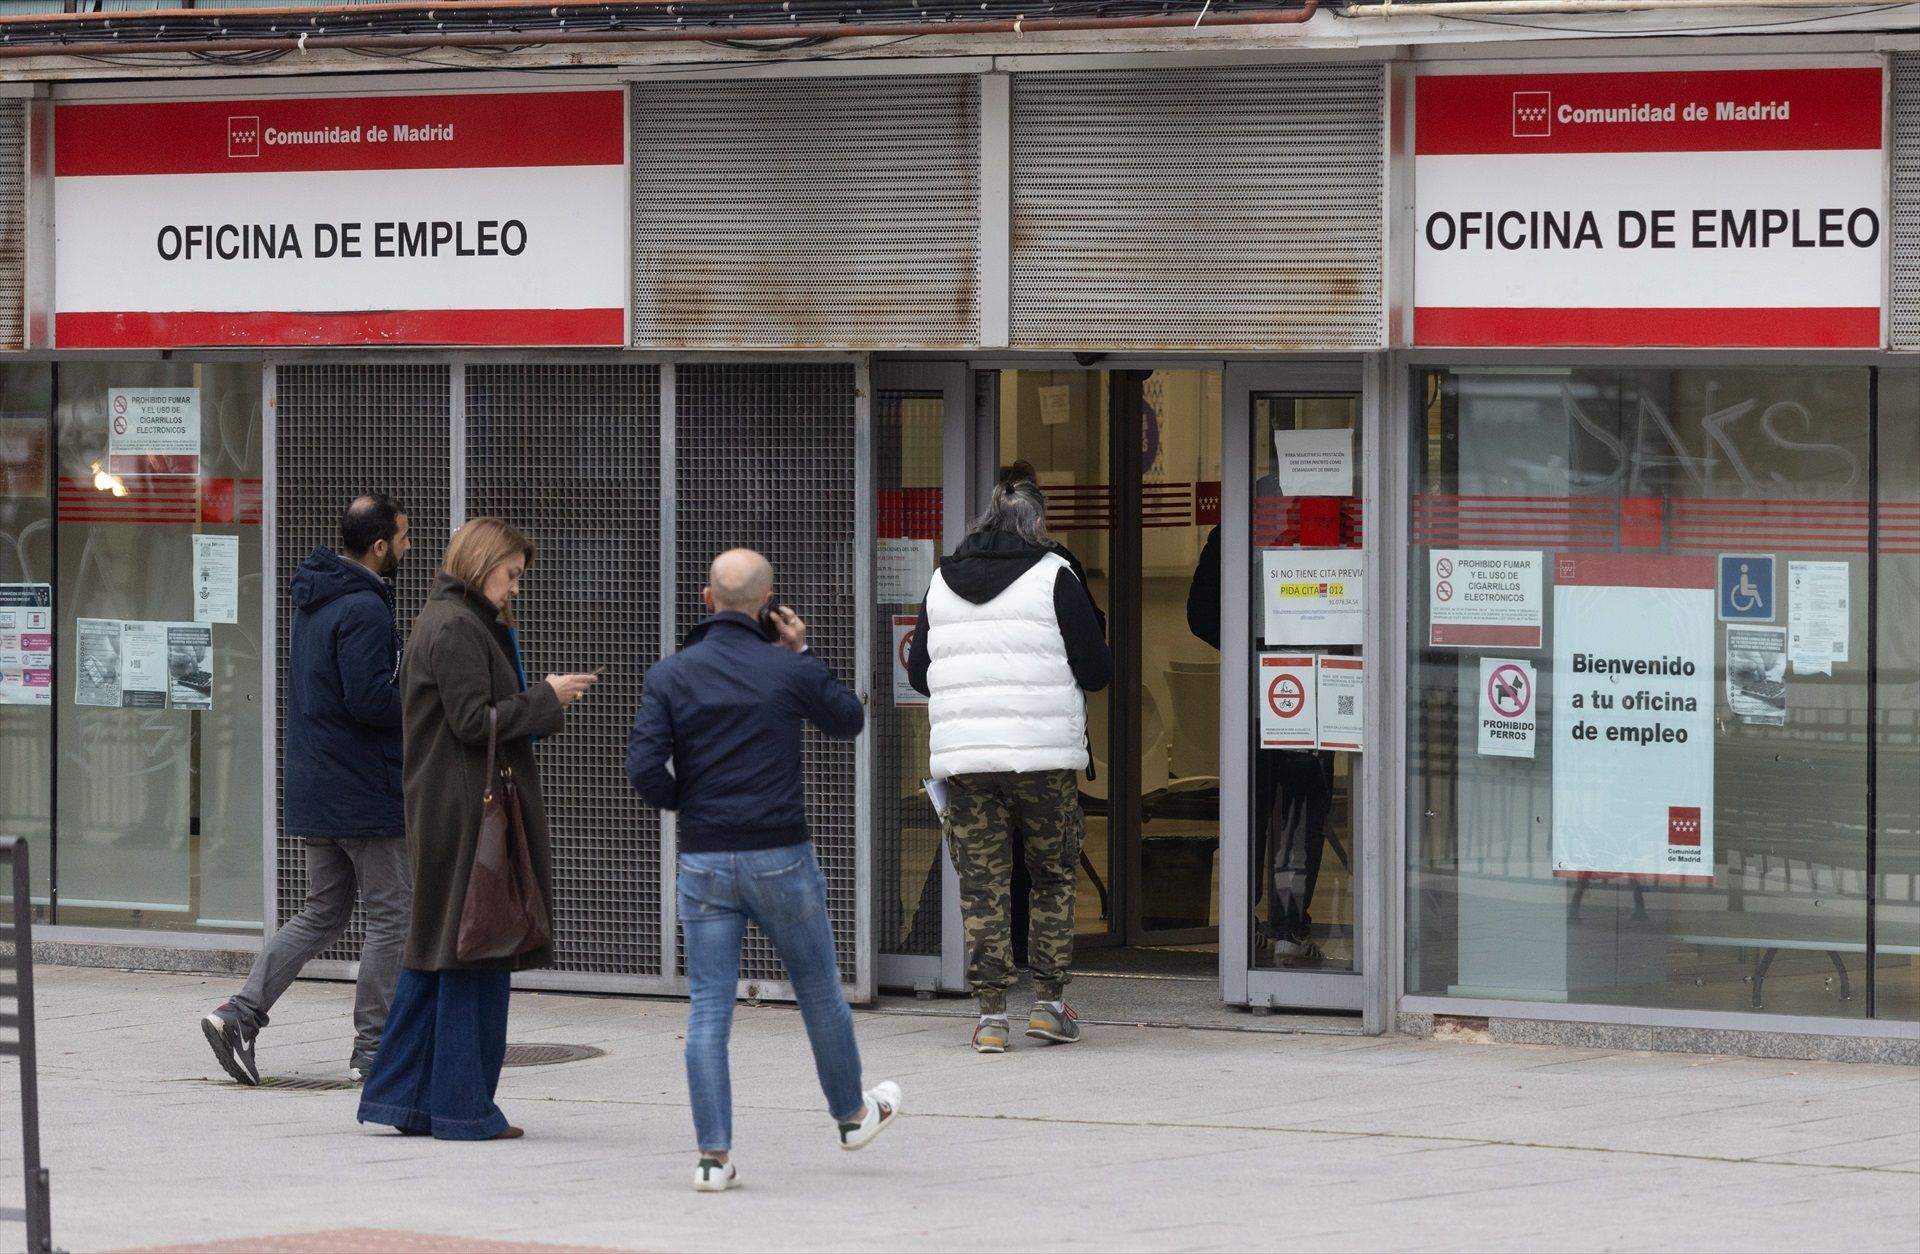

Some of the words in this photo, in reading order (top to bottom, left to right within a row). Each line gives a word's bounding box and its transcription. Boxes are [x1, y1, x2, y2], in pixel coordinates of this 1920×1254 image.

[1557, 103, 1676, 124] Comunidad
[1683, 102, 1709, 122] de
[1715, 101, 1790, 121] Madrid
[264, 127, 361, 145] Comunidad
[366, 126, 388, 142] de
[393, 124, 454, 142] Madrid
[1425, 210, 1603, 251] OFICINA
[1618, 210, 1676, 249] DE
[1692, 207, 1880, 249] EMPLEO
[156, 223, 301, 261] OFICINA
[314, 223, 362, 259] DE
[374, 219, 528, 258] EMPLEO
[132, 396, 167, 404] PROHIBIDO
[168, 396, 191, 404] FUMAR
[157, 406, 170, 414] USO
[172, 406, 181, 414] DE
[140, 416, 183, 424] CIGARRILLOS
[1458, 560, 1501, 568] PROHIBIDO
[1504, 560, 1531, 568] FUMAR
[1271, 570, 1277, 578] SI
[1280, 570, 1293, 578] NO
[1296, 569, 1317, 578] TIENE
[1320, 569, 1336, 578] CITA
[1478, 571, 1487, 579] EL
[1490, 571, 1506, 580] USO
[1508, 572, 1518, 580] DE
[1280, 586, 1300, 595] PIDA
[1302, 586, 1319, 595] CITA
[1329, 586, 1343, 595] 012
[1468, 582, 1520, 591] CIGARRILLOS
[1464, 592, 1525, 602] ELECTRÓNICOS
[1573, 653, 1695, 676] Bienvenido
[1572, 693, 1584, 709] a
[1591, 690, 1613, 709] tu
[1622, 691, 1697, 712] oficina
[1483, 720, 1535, 731] PROHIBIDO
[1490, 730, 1526, 740] PERROS
[1572, 720, 1598, 740] de
[1606, 723, 1688, 746] empleo
